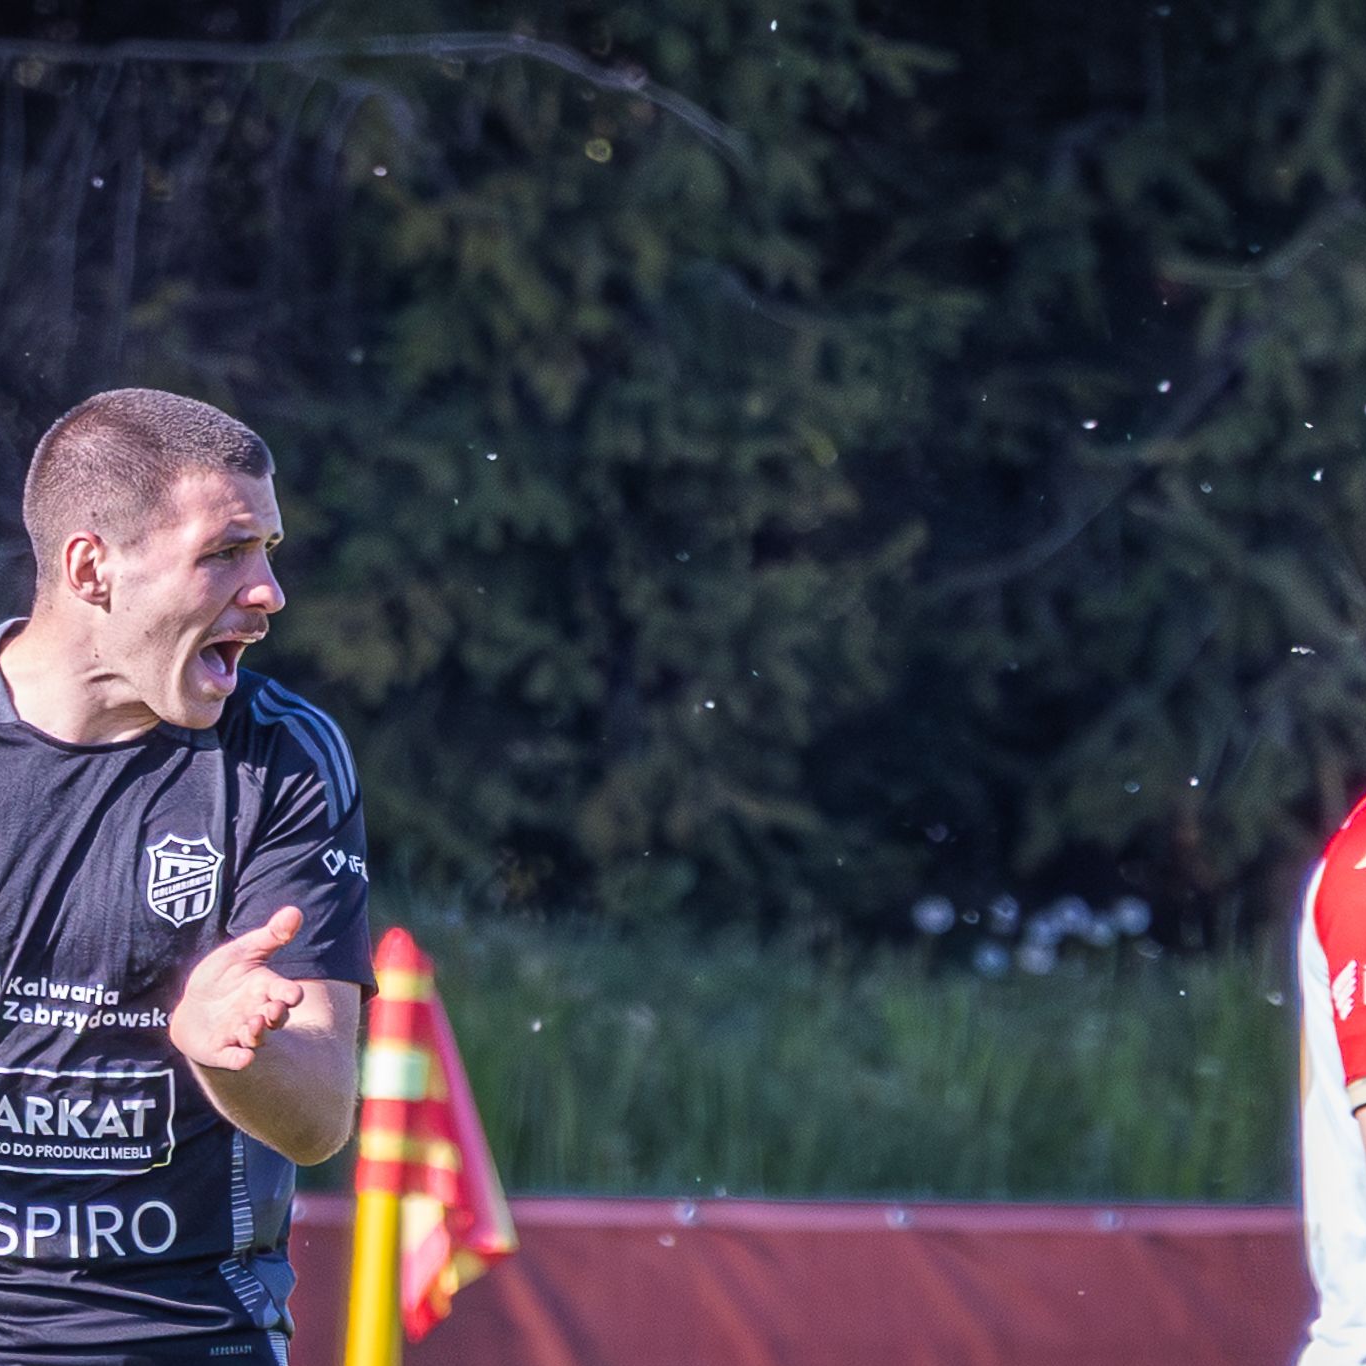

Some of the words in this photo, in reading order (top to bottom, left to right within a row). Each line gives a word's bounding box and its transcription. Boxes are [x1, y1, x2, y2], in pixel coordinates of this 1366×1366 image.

[5, 976, 120, 1006] Kalwaria
[2, 1001, 172, 1034] Zebrzydowsk
[13, 1142, 33, 1157] DO
[35, 1145, 109, 1160] PRODUKCJI
[111, 1146, 152, 1160] MEBLI
